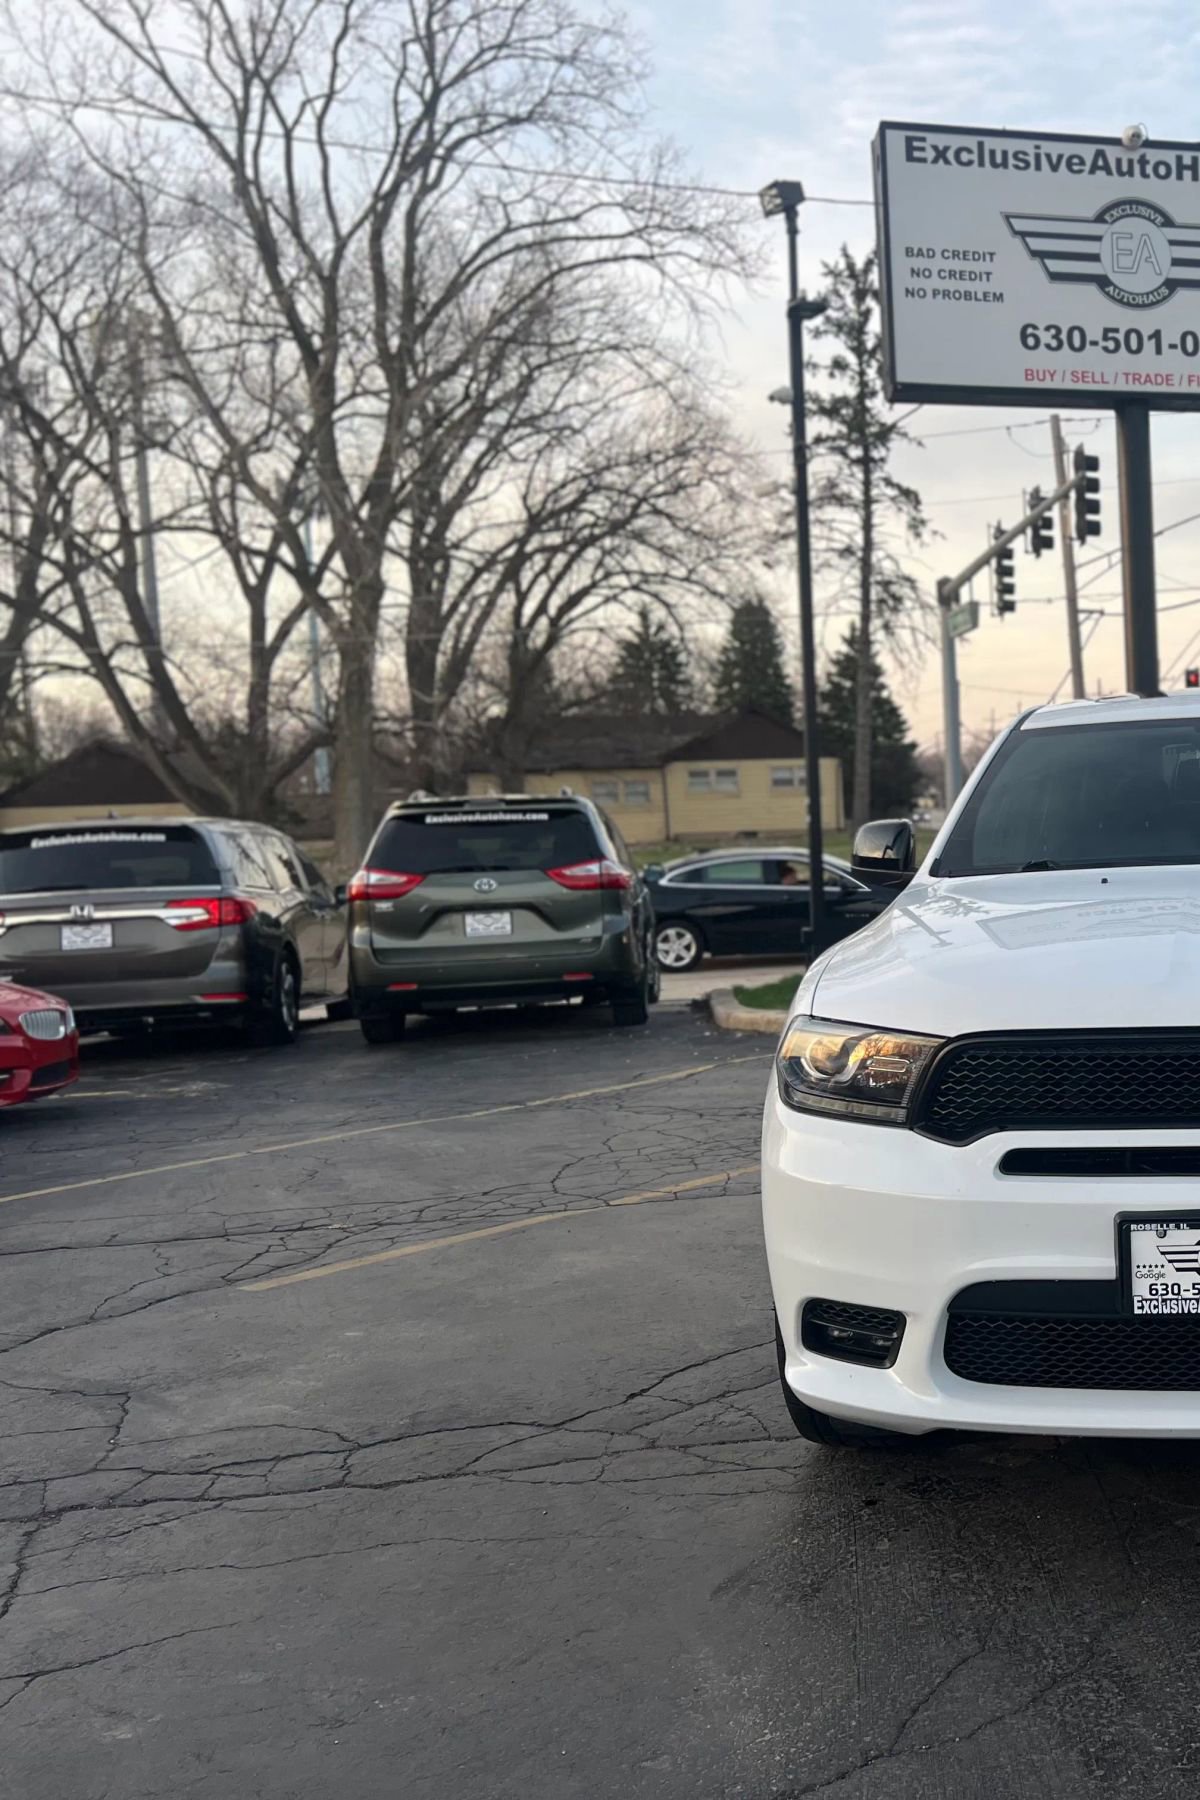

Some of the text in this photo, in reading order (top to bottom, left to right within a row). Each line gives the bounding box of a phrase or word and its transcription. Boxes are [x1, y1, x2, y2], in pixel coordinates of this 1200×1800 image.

[1104, 205, 1165, 226] EXCLUSIVE
[905, 246, 996, 263] BAD CREDIT
[1111, 231, 1162, 276] EA
[910, 267, 993, 282] NO CREDIT
[905, 287, 1004, 303] NO PROBLEM
[1104, 285, 1169, 305] AUTOHAUS
[1024, 368, 1057, 382] BUY
[1070, 370, 1109, 385] SELL
[1123, 372, 1175, 387] TRADE
[1130, 1223, 1178, 1231] ROSELLE,
[1135, 1270, 1166, 1280] Google
